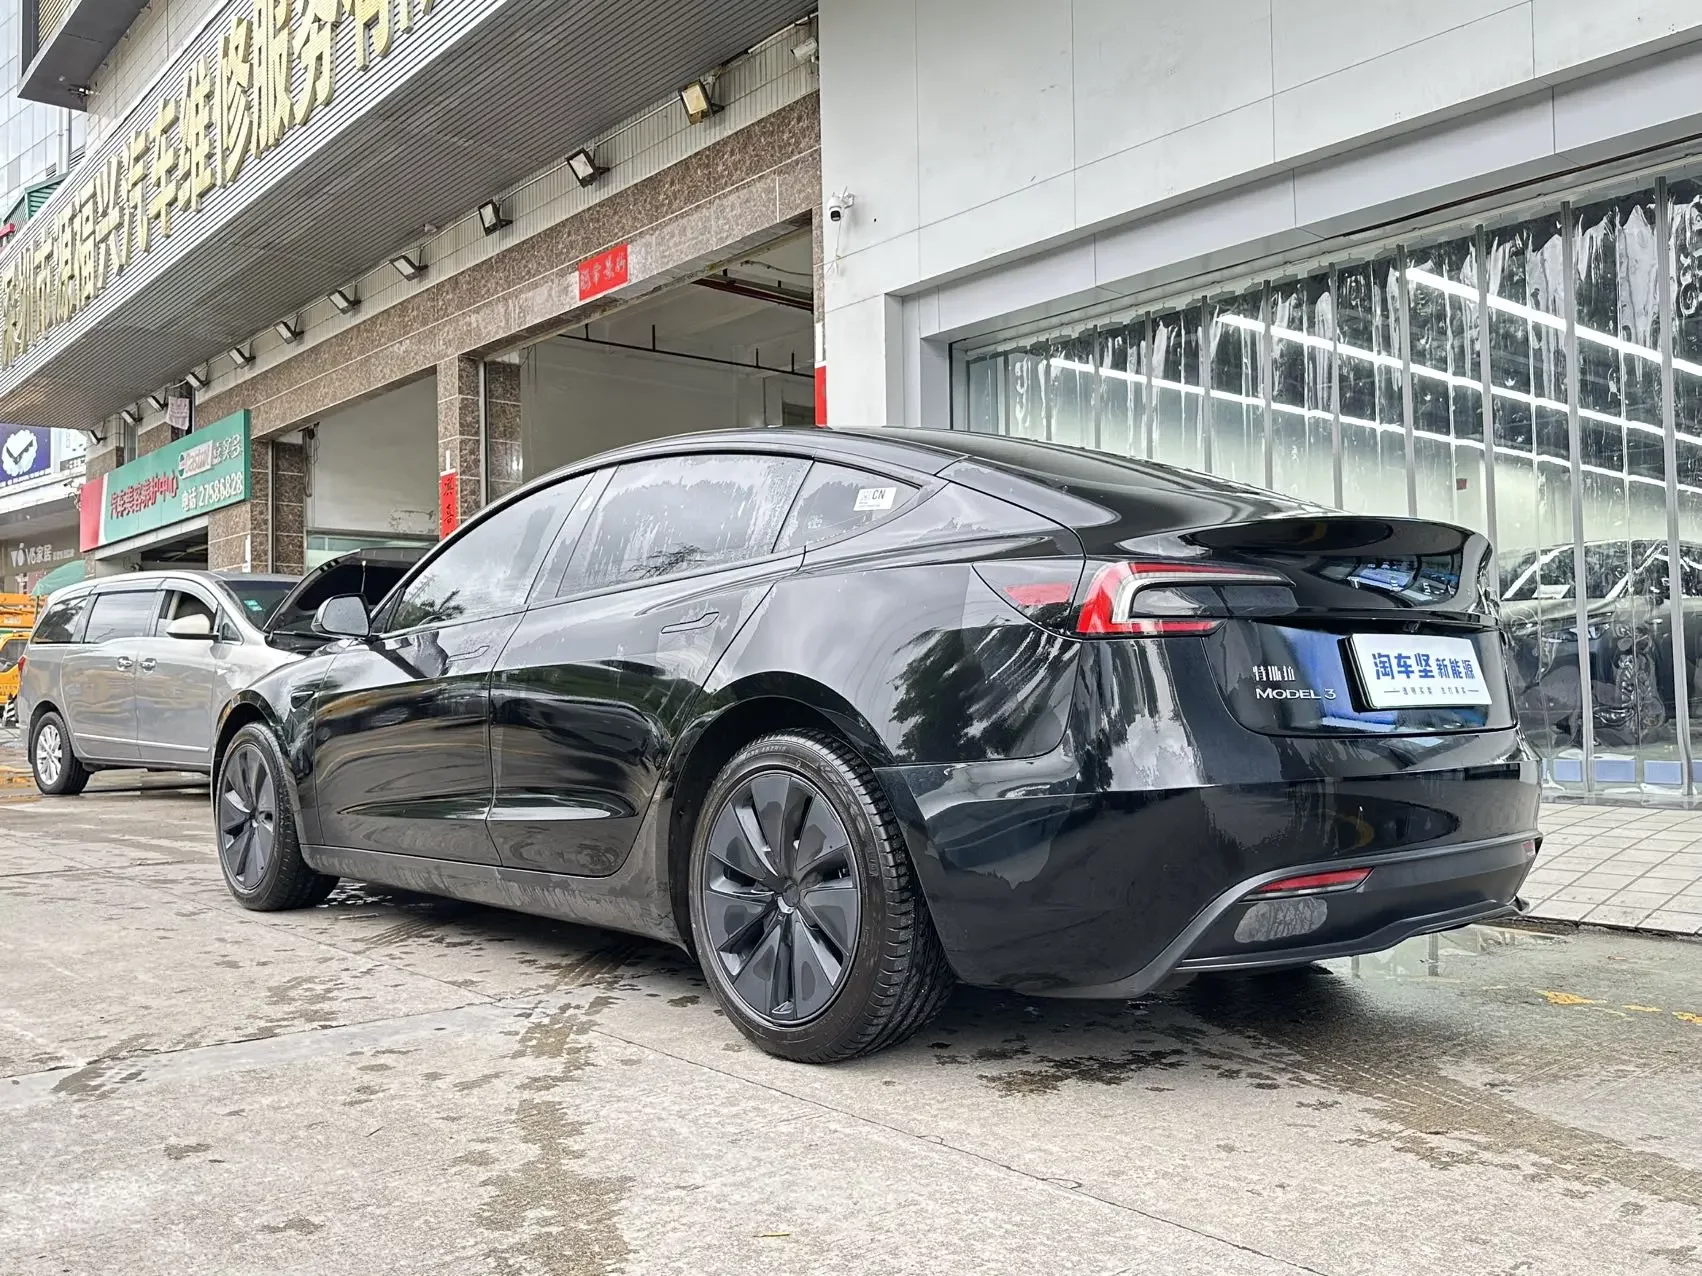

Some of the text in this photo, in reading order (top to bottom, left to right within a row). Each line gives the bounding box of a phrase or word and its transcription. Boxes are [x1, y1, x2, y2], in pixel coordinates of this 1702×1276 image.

[182, 471, 243, 511] 电话 27586828
[872, 489, 886, 500] CN
[1256, 688, 1337, 700] MODEL 3
